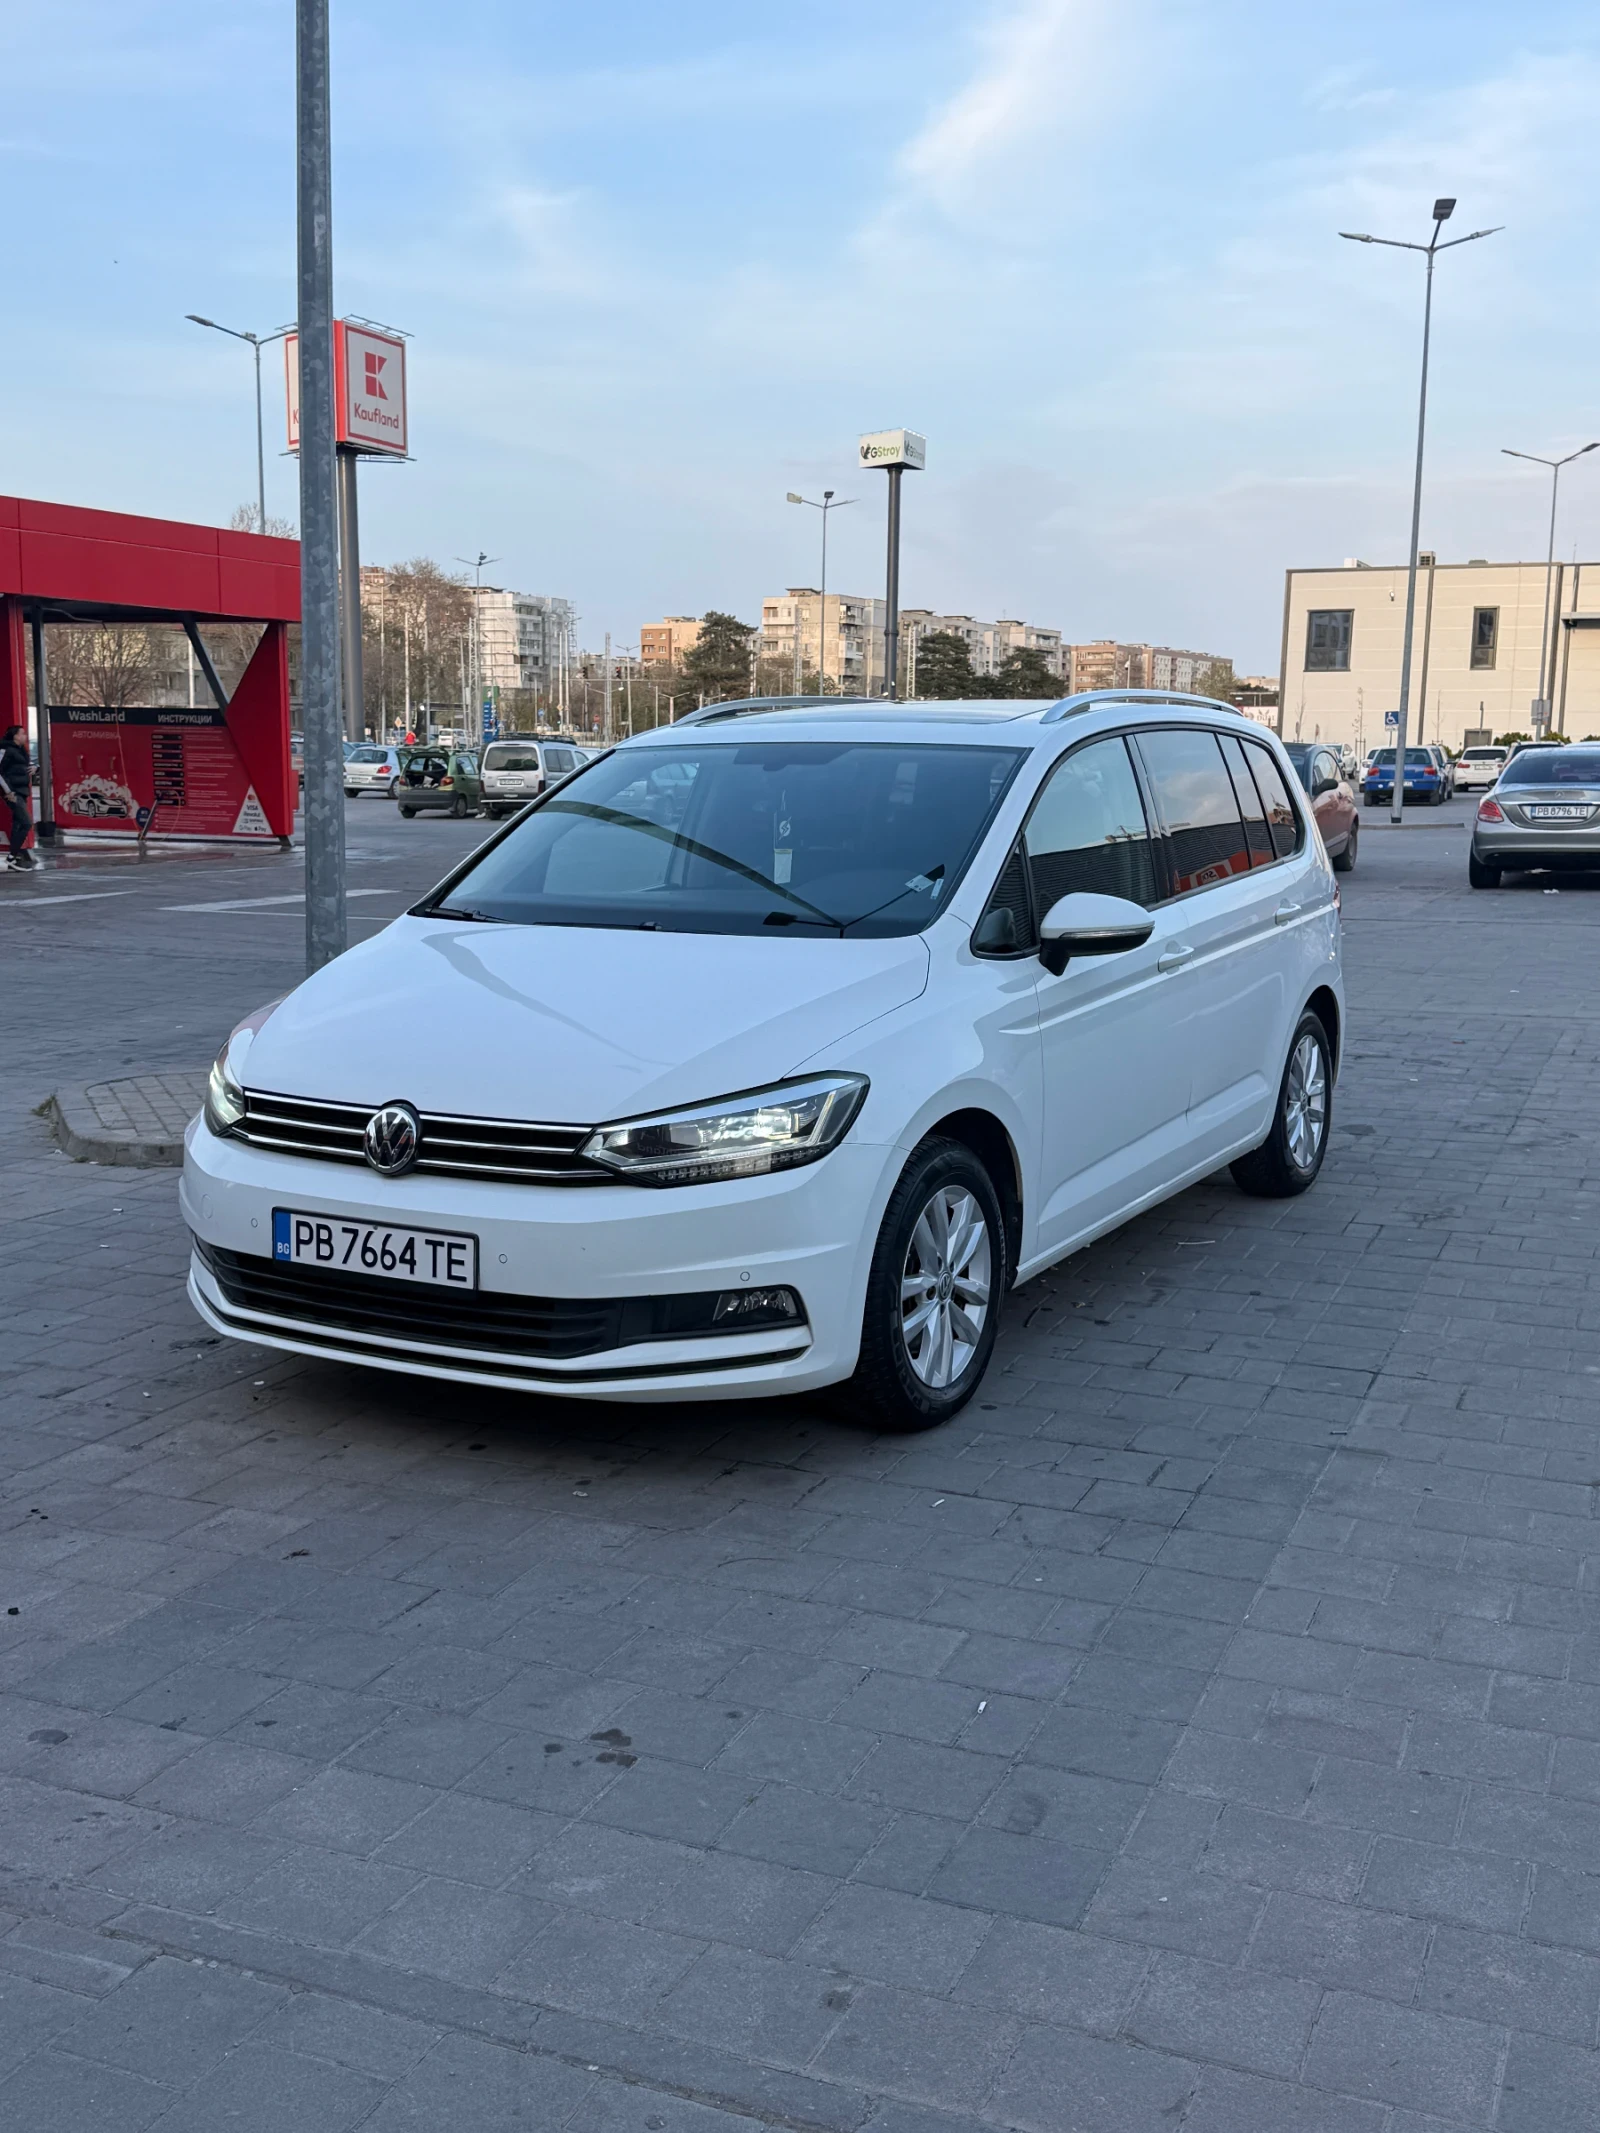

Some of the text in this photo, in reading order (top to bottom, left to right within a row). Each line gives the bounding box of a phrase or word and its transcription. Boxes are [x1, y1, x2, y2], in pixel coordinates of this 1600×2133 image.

[354, 402, 400, 429] Kaufland
[68, 710, 126, 722] WashLand
[157, 714, 213, 724] ИНСТРУКЦИИ
[72, 730, 121, 740] АВТОМИВКА
[276, 1241, 290, 1255] BG
[295, 1219, 468, 1283] PB 7664 TE
